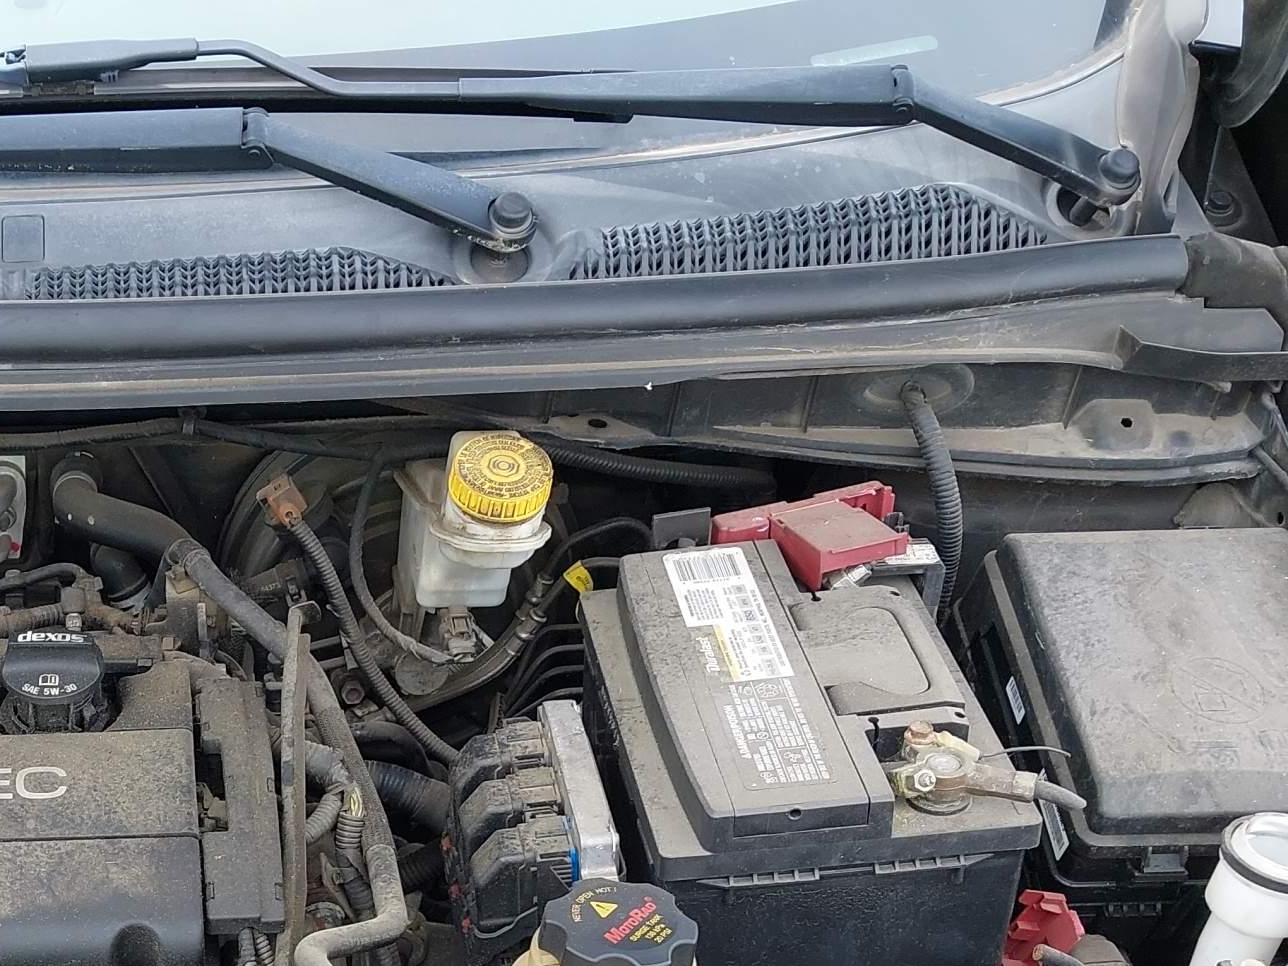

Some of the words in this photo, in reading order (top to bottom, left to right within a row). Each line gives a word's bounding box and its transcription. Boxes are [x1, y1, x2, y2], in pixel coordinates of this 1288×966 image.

[17, 631, 88, 643] dexos
[21, 683, 40, 695] SAE
[43, 683, 78, 696] 5W-30
[575, 891, 594, 903] OPEN
[595, 886, 612, 894] HOT
